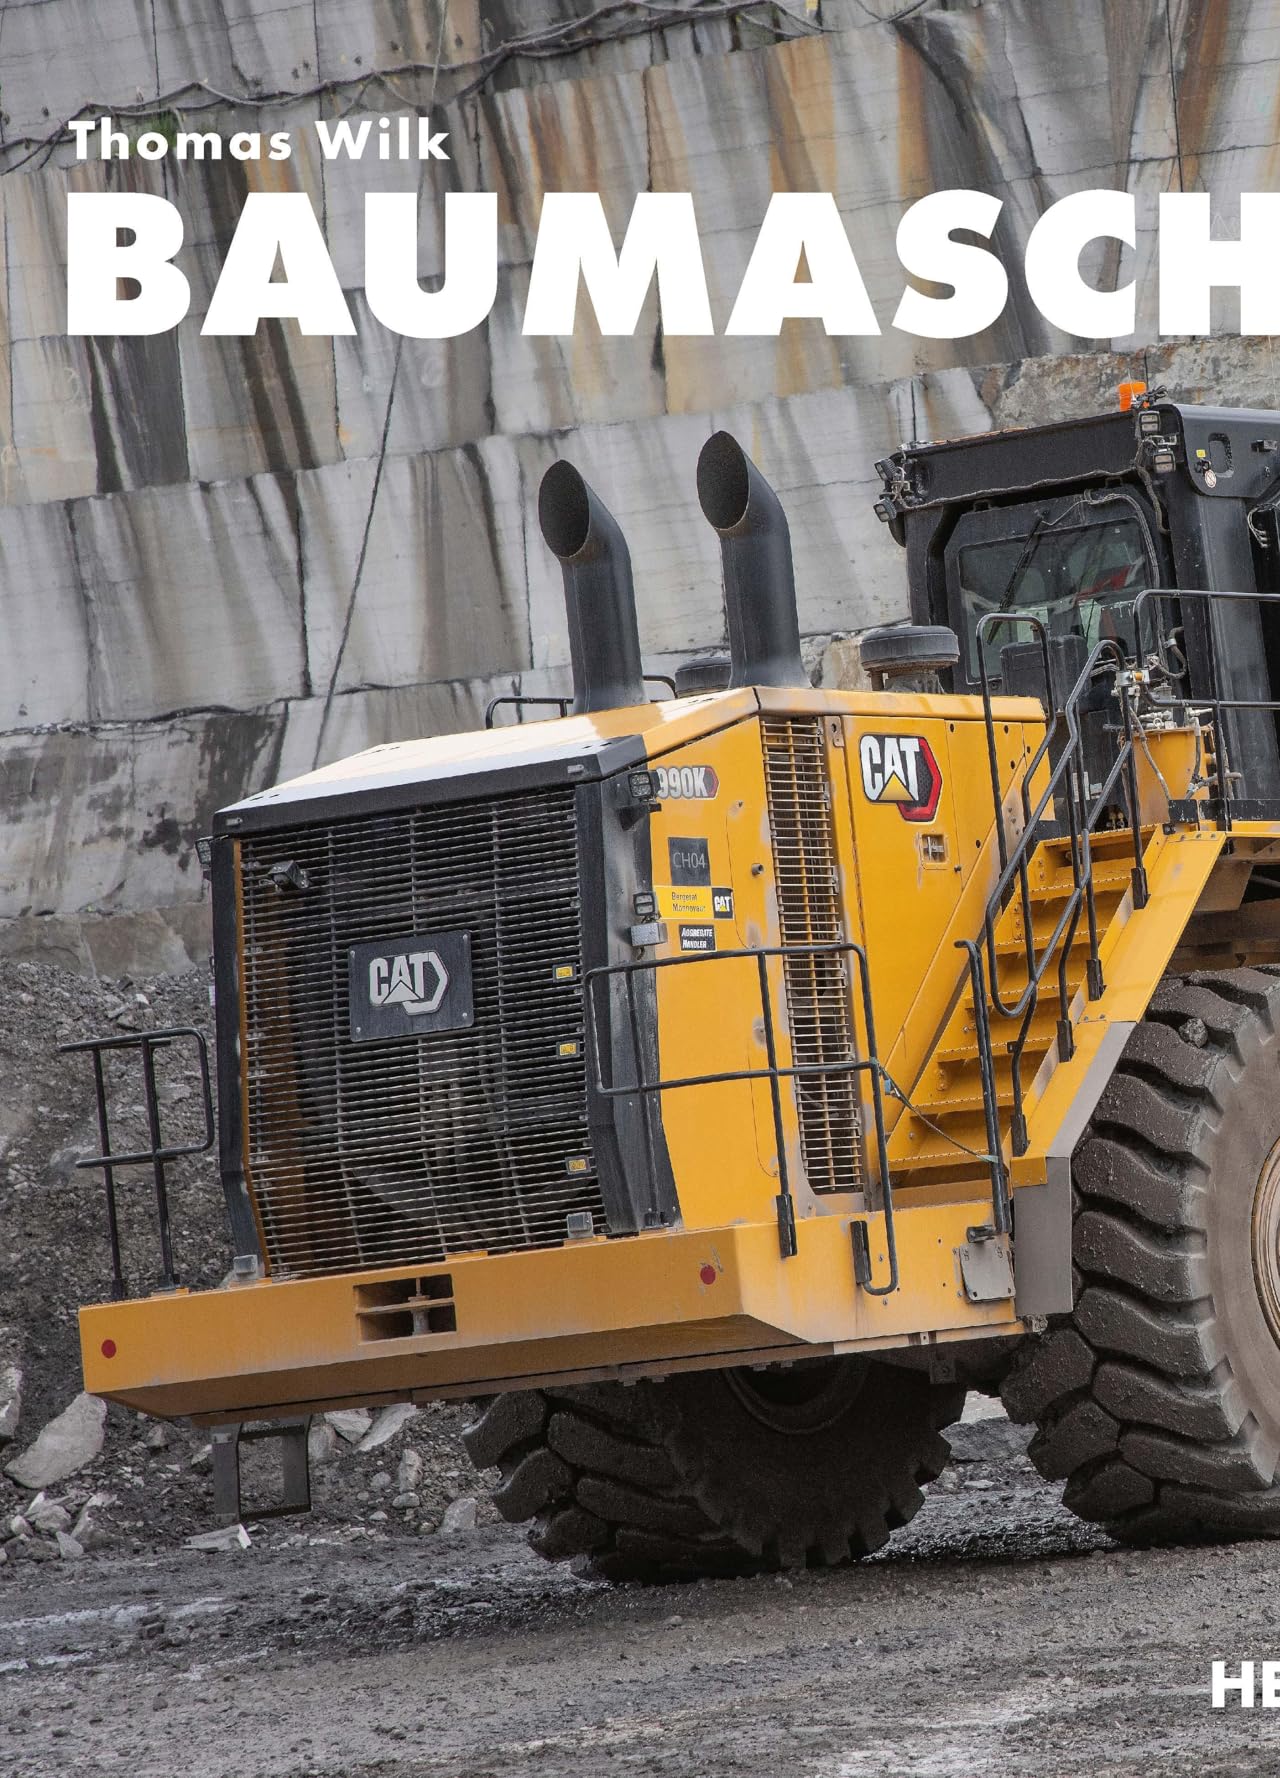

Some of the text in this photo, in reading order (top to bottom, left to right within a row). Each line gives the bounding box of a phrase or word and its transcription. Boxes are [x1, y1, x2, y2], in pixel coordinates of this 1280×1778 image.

[860, 735, 920, 801] CAT
[656, 766, 709, 798] 990K
[672, 852, 706, 868] CH04
[713, 895, 731, 912] CAT
[682, 940, 707, 949] HANDLER
[369, 952, 429, 1006] CAT
